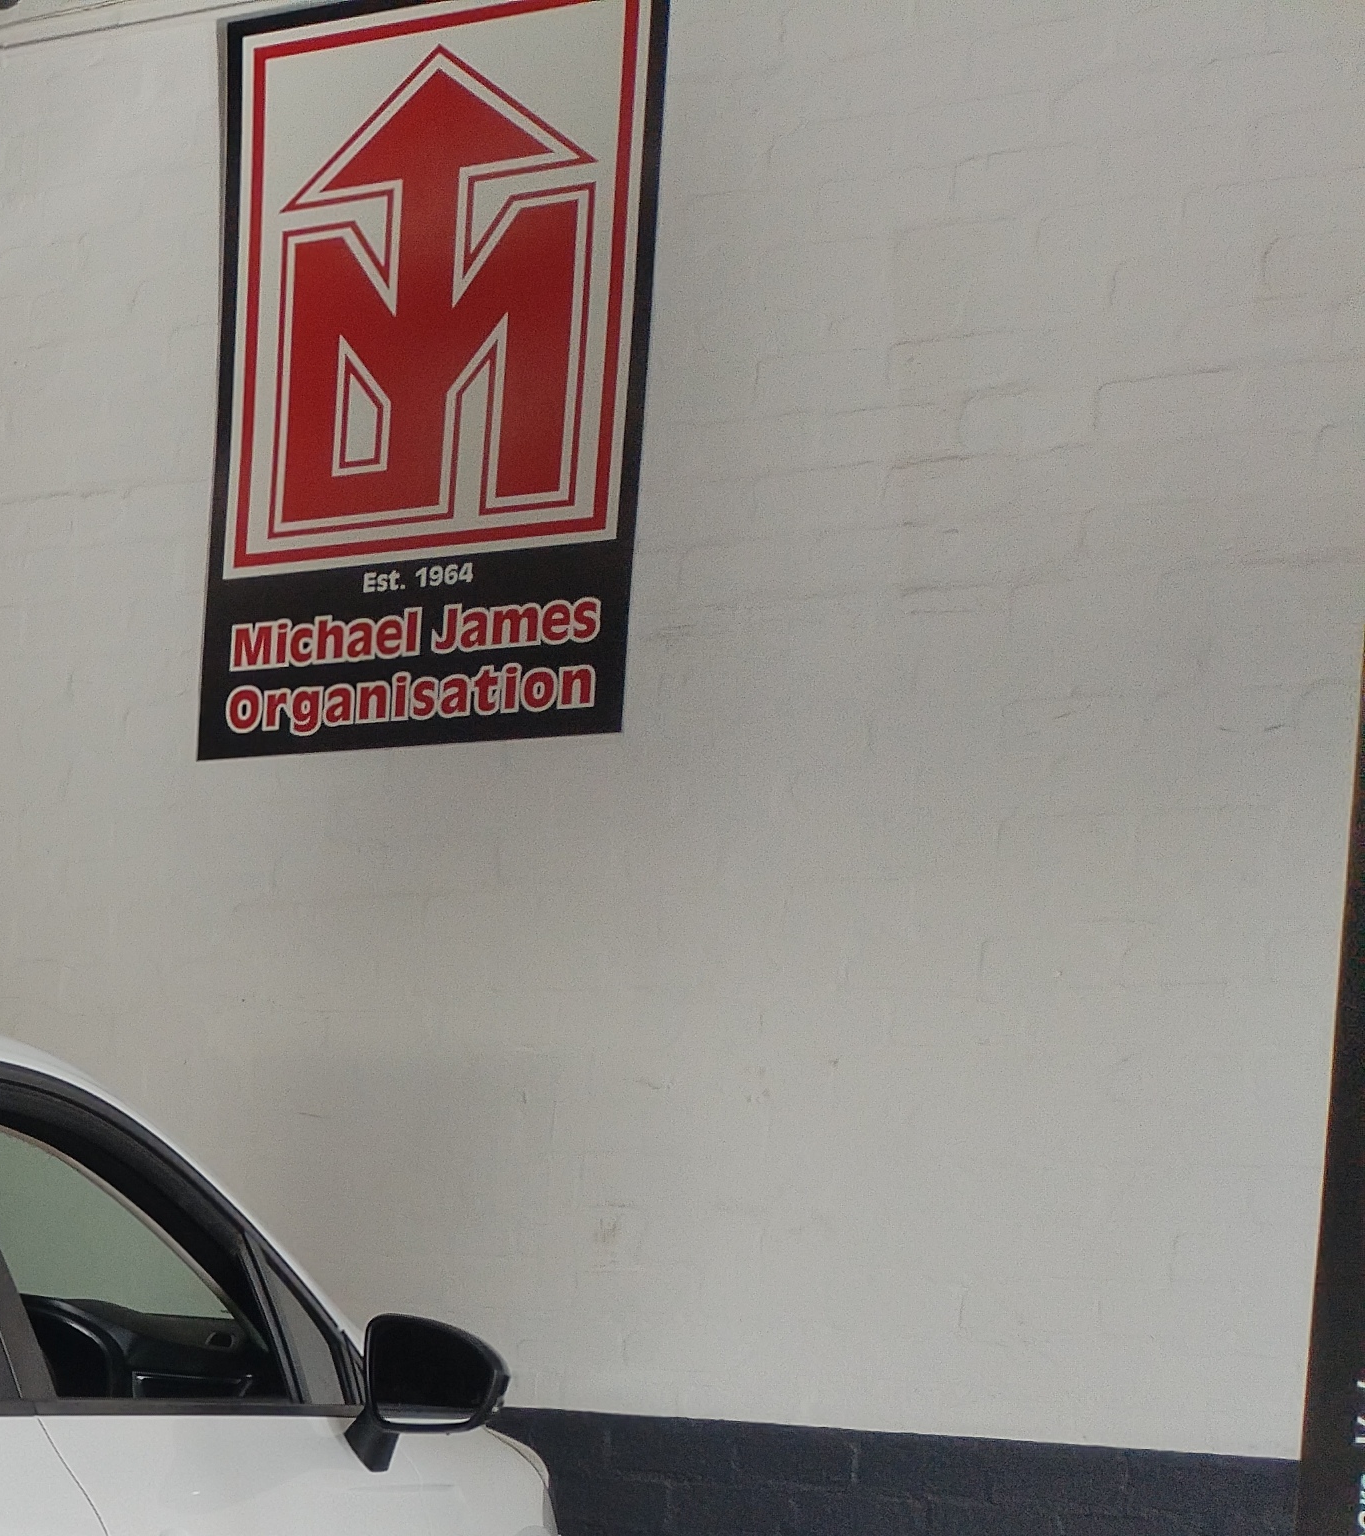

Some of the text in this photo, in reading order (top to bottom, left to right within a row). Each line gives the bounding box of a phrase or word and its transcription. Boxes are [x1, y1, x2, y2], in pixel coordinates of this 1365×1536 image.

[362, 561, 475, 594] Est. 1964
[228, 596, 602, 673] Michael James
[225, 662, 596, 737] Organisation
